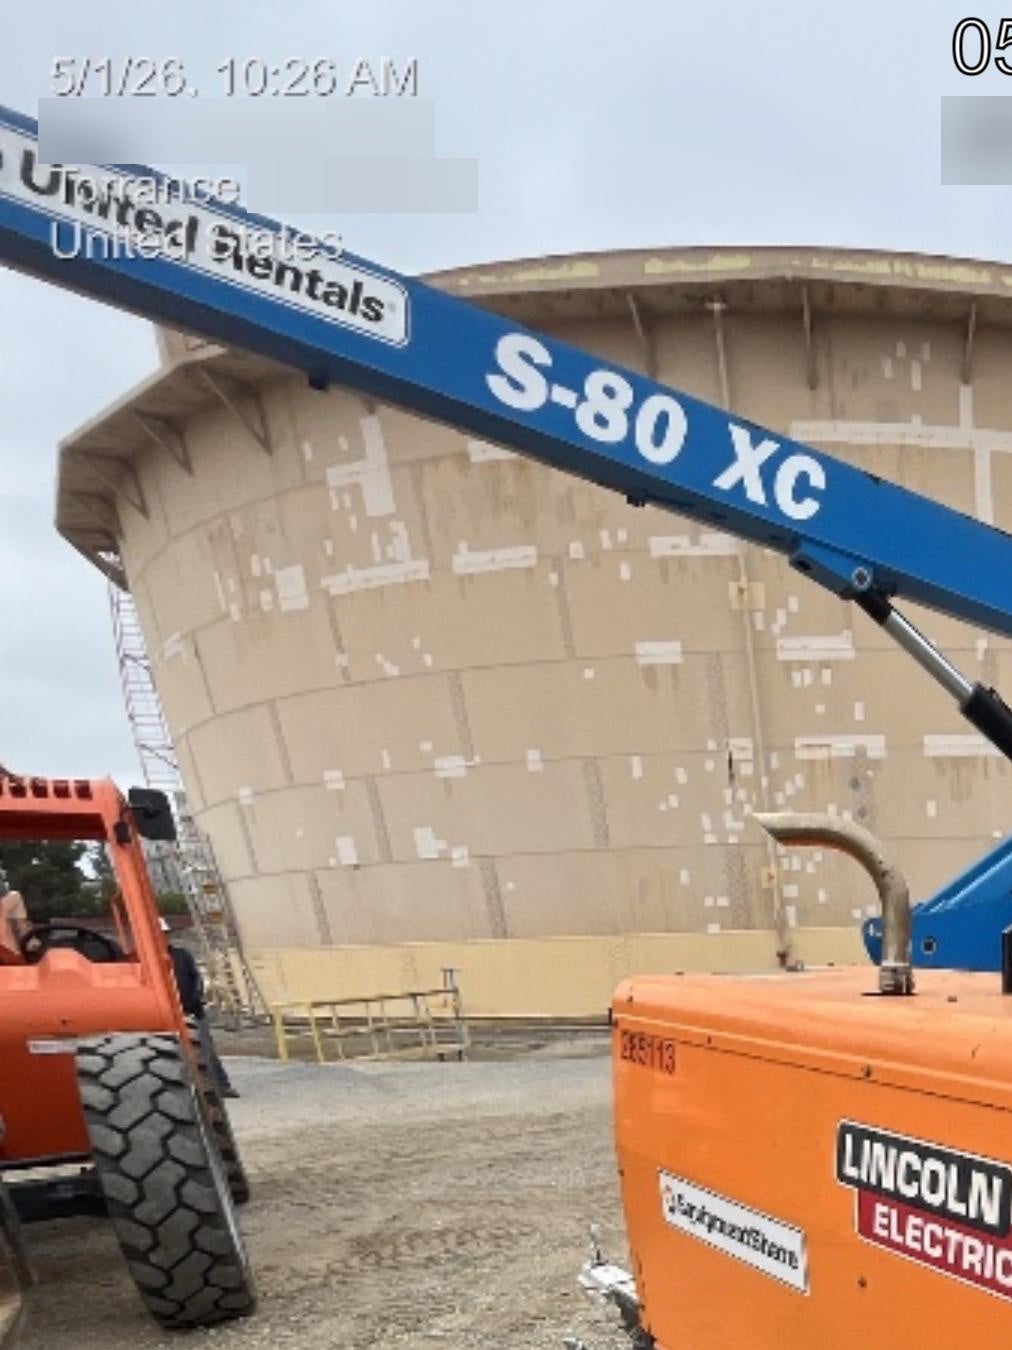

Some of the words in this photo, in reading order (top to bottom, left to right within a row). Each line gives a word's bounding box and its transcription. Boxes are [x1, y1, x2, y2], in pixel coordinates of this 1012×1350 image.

[20, 148, 199, 254] United
[485, 332, 688, 465] S-80
[712, 422, 826, 521] XC
[843, 1132, 1003, 1226] LINCOLN
